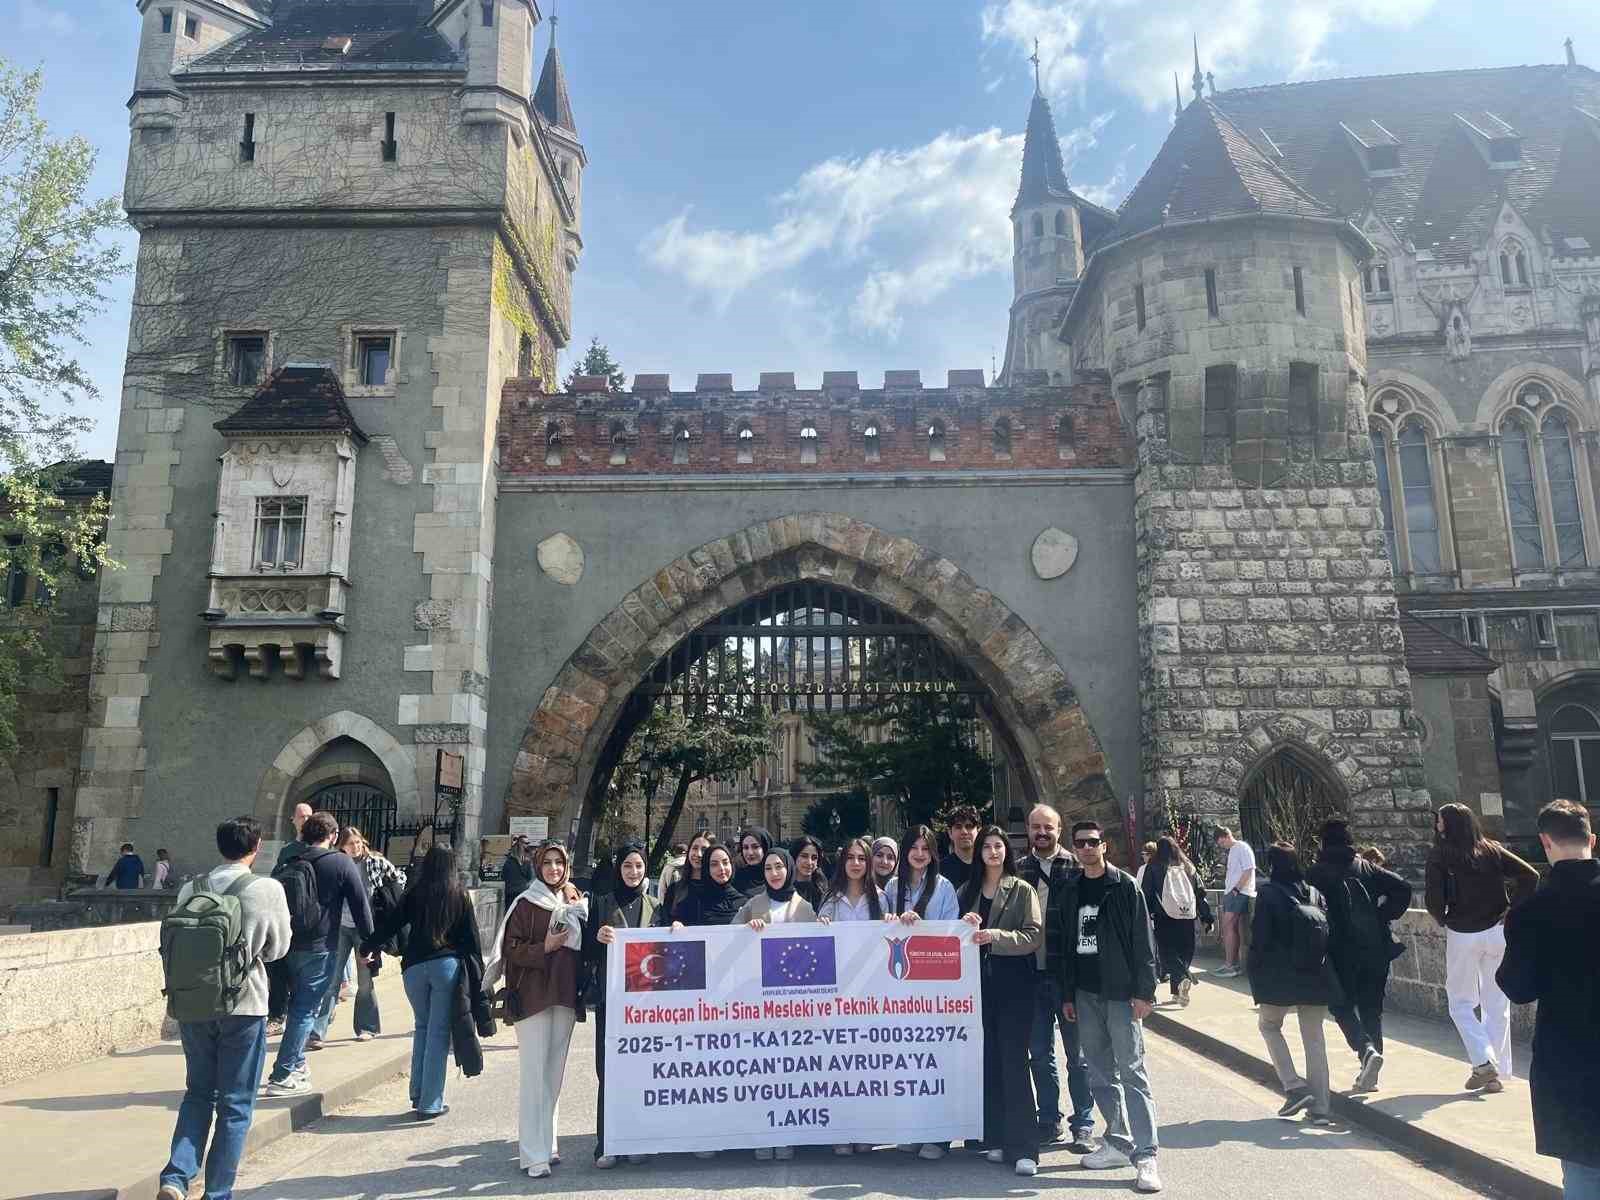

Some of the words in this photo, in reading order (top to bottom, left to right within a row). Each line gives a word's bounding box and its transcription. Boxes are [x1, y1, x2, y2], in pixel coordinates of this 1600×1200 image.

[663, 683, 725, 694] MAGYAR
[624, 1005, 694, 1024] Karakoçan
[698, 997, 729, 1022] İbn-i
[732, 1001, 760, 1020] Sina
[763, 999, 814, 1019] Mesleki
[817, 1001, 832, 1016] ve
[835, 997, 879, 1015] Teknik
[882, 996, 932, 1014] Anadolu
[936, 995, 973, 1013] Lisesi
[617, 1026, 968, 1054] 2025-1-TR01-KA122-VET-000322974
[652, 1056, 823, 1079] KARAKOÇAN'DAN
[828, 1053, 938, 1072] AVRUPA'YA
[644, 1086, 729, 1107] DEMANS
[734, 1080, 889, 1102] UYGULAMALARI
[894, 1078, 945, 1097] STAJI
[767, 1108, 830, 1127] 1.AKIŞ
